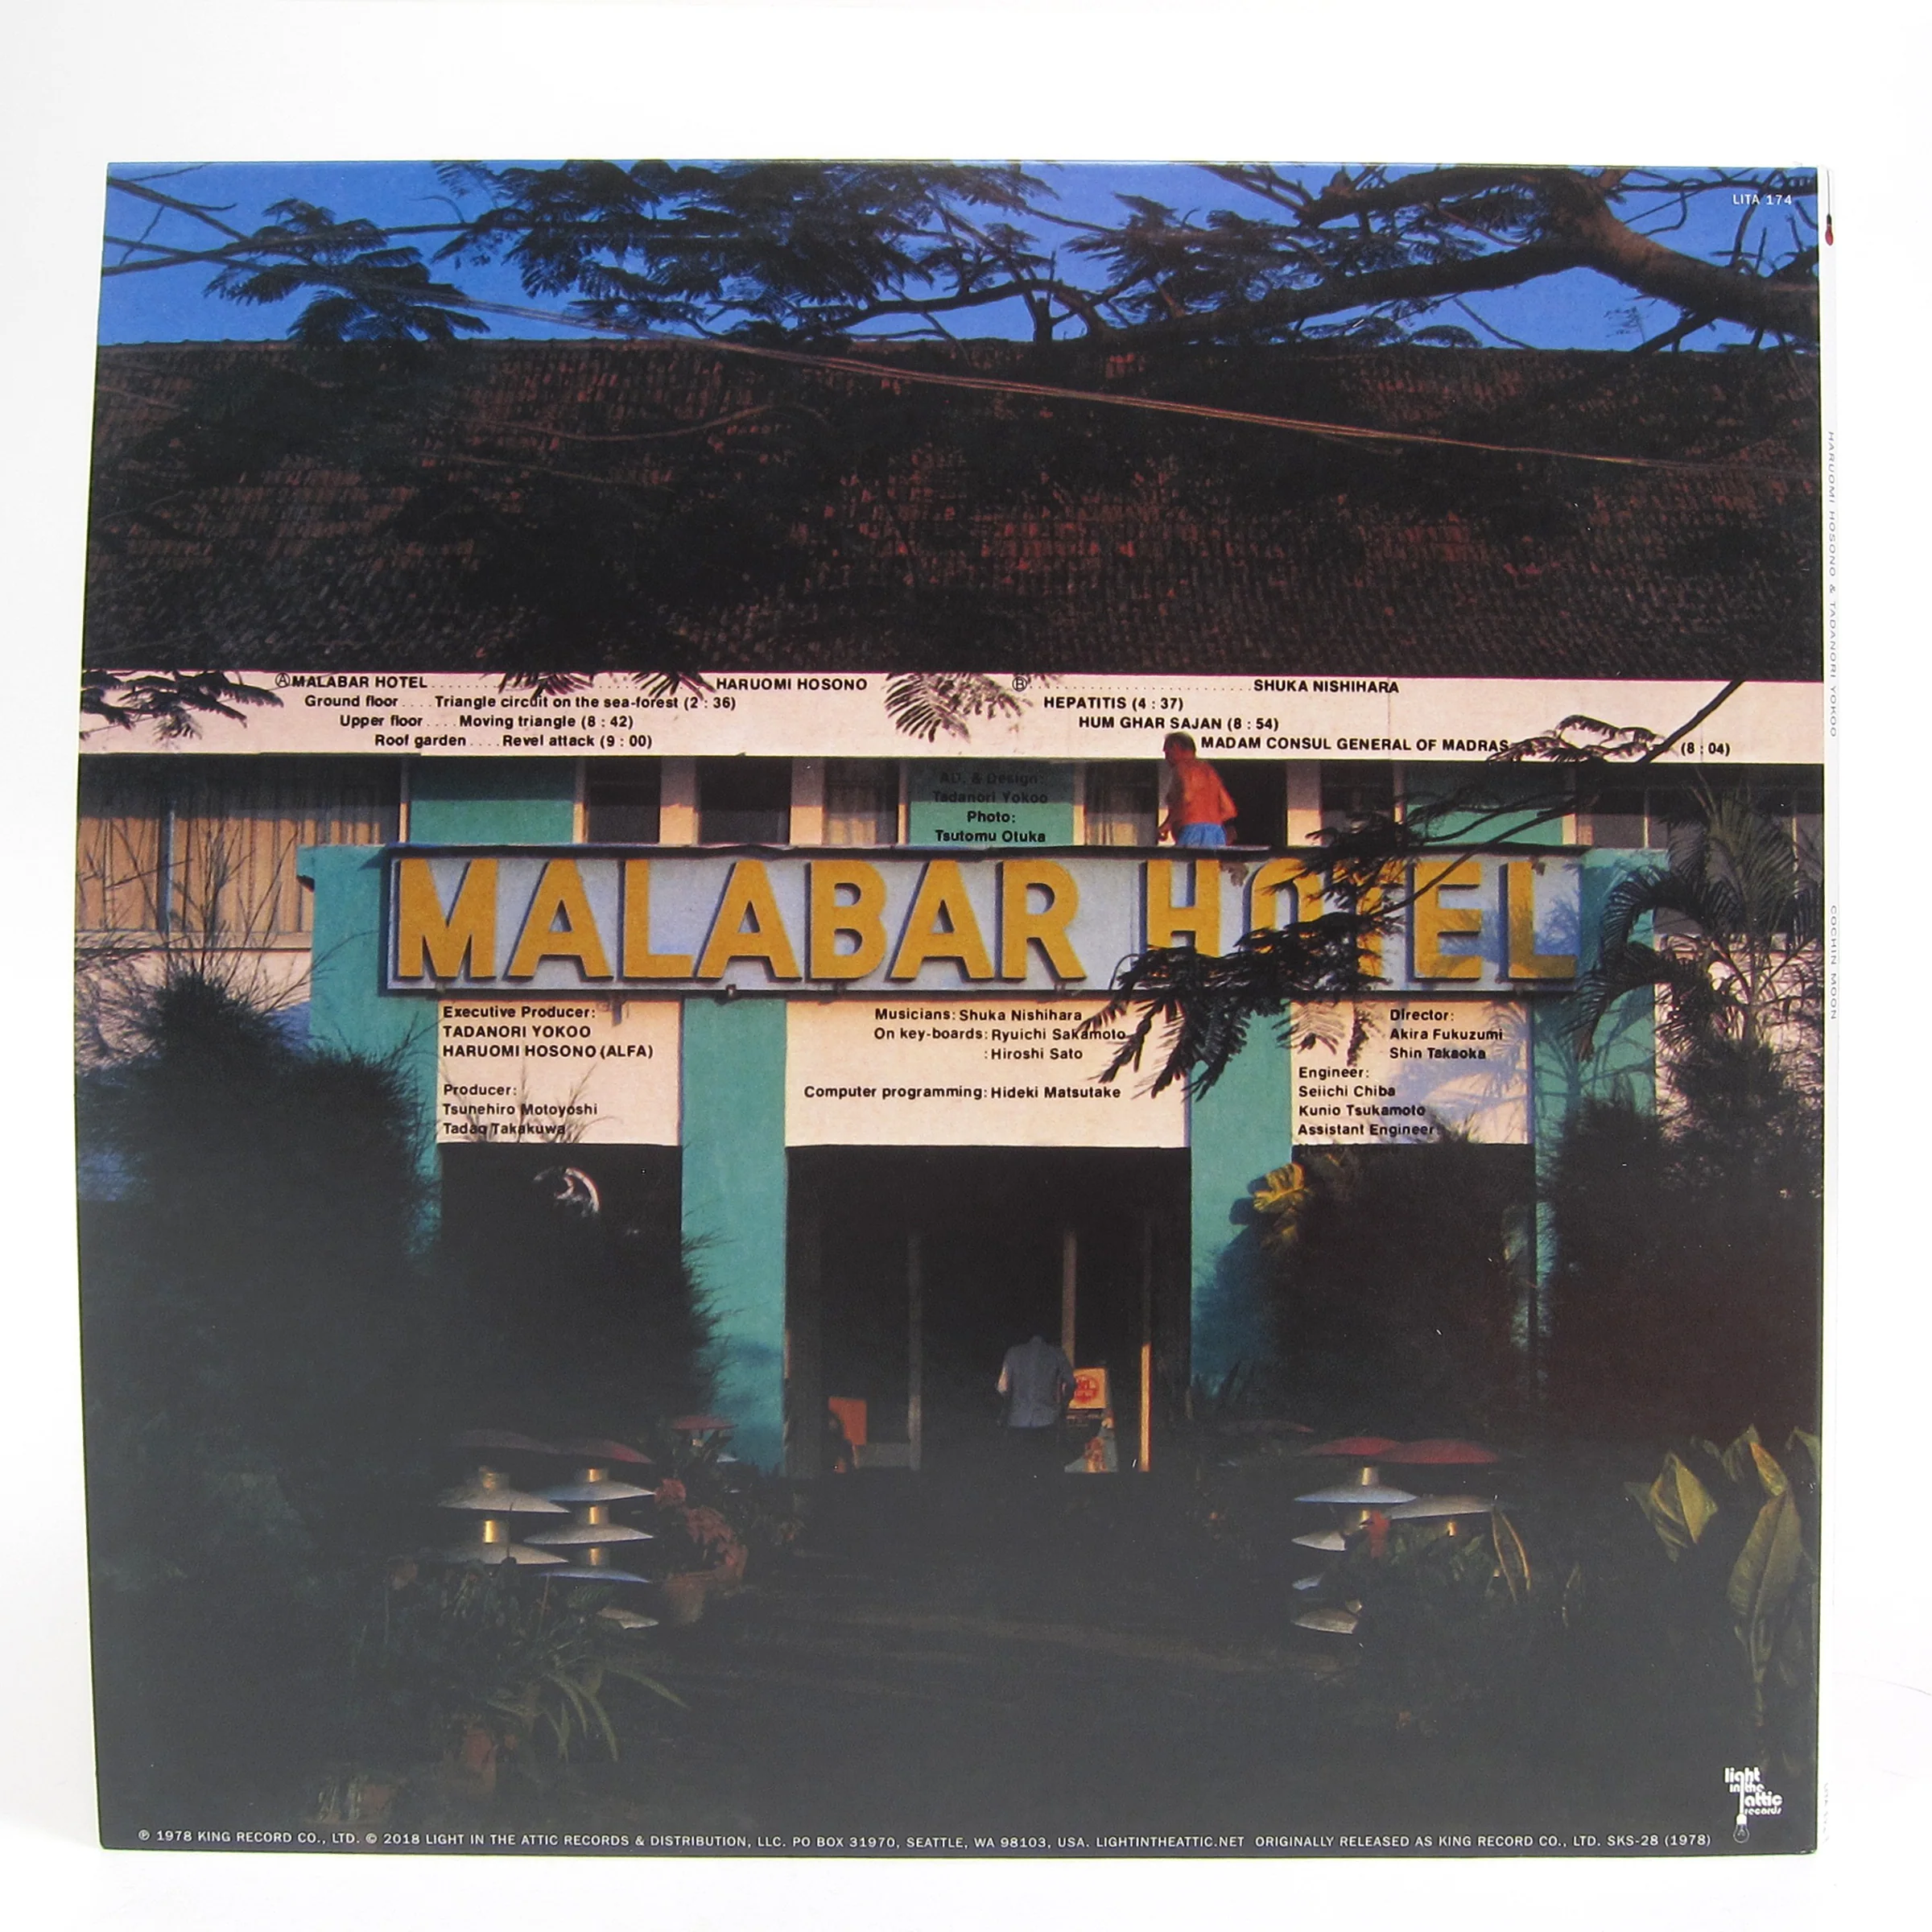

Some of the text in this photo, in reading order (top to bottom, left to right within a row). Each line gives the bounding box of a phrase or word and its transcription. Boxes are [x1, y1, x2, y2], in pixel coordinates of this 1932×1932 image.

[1733, 194, 1792, 205] LITA 174
[292, 675, 369, 687] MALABAR
[375, 676, 427, 688] HOTEL
[716, 678, 792, 690] HARUOMI
[797, 678, 868, 691] HOSONO
[1253, 679, 1309, 691] SHUKA
[1313, 680, 1399, 693] NISHIHARA
[304, 696, 360, 708] Ground
[365, 696, 398, 708] floor
[435, 696, 496, 709] Triangle
[501, 696, 547, 708] circuit
[554, 698, 571, 708] on
[576, 696, 599, 708] the
[604, 696, 678, 709] sea-forest
[1044, 696, 1127, 709] HEPATITIS
[340, 715, 385, 729] Upper
[390, 715, 423, 727] floor
[460, 715, 514, 729] Moving
[518, 716, 576, 729] triangle
[1079, 716, 1115, 729] HUM
[1120, 716, 1165, 729] GHAR
[1170, 717, 1222, 729] SAJAN
[375, 734, 411, 746] Roof
[415, 735, 467, 749] garden
[502, 735, 543, 747] Revel
[549, 735, 595, 747] attack
[1201, 737, 1261, 749] MADAM
[1266, 737, 1331, 749] CONSUL
[1336, 738, 1410, 750] GENERAL
[1416, 740, 1438, 751] OF
[1443, 739, 1509, 752] MADRAS
[933, 791, 1048, 803] Tadanori Yokoo
[967, 811, 1015, 823] Photo:
[935, 830, 1046, 842] Tsutomu Otuka
[396, 857, 1088, 981] MALABAR
[443, 1006, 596, 1018] Executive Producer:
[875, 1009, 1082, 1021] Musicians: Shuka Nishihara
[1389, 1009, 1454, 1022] Director:
[443, 1026, 591, 1038] TADANORI YOKOO
[873, 1027, 1126, 1042] On key-boards: Ryuichi Sakamoto
[1389, 1029, 1503, 1040] Akira Fukuzumi
[443, 1045, 654, 1059] HARUOMI HOSONO (ALFA)
[1050, 1048, 1084, 1060] Sato
[1389, 1047, 1486, 1059] Shin Takaoka
[1298, 1067, 1368, 1080] Engineer:
[444, 1084, 517, 1096] Producer:
[804, 1086, 1121, 1100] Computer programming: Hideki Matsutake
[1298, 1086, 1396, 1097] Seiichi Chiba
[443, 1104, 597, 1117] Tsunehiro Motoyoshi
[1298, 1105, 1426, 1117] Kunio Tsukamoto
[443, 1122, 566, 1135] Tadao Takakuwa
[1298, 1124, 1434, 1137] Assistant Engineer
[1724, 1767, 1761, 1783] light
[1744, 1783, 1765, 1793] the
[1744, 1791, 1783, 1807] attic
[1744, 1807, 1781, 1815] records
[156, 1831, 192, 1842] 1978
[197, 1831, 231, 1843] KING
[237, 1832, 292, 1843] RECORD
[297, 1833, 326, 1844] CO.,
[332, 1833, 360, 1844] LTD.
[382, 1834, 420, 1844] 2018
[426, 1834, 464, 1845] LIGHT
[470, 1835, 484, 1845] IN
[489, 1835, 516, 1845] THE
[521, 1835, 559, 1846] ATTIC
[564, 1835, 630, 1846] RECORDS
[635, 1835, 645, 1847] &
[650, 1835, 751, 1848] DISTRIBUTION,
[758, 1836, 786, 1847] LLC.
[792, 1836, 811, 1847] PO
[816, 1836, 844, 1847] BOX
[849, 1836, 900, 1849] 31970,
[906, 1837, 968, 1850] SEATTLE,
[973, 1837, 995, 1848] WA
[1001, 1837, 1051, 1850] 98103,
[1058, 1837, 1090, 1848] USA.
[1096, 1837, 1245, 1848] LIGHTINTHEATTIC.NET
[1254, 1836, 1335, 1847] ORIGINALLY
[1339, 1836, 1410, 1847] RELEASED
[1414, 1835, 1432, 1847] AS
[1438, 1835, 1472, 1847] KING
[1477, 1835, 1534, 1847] RECORD
[1539, 1835, 1567, 1849] CO.,
[1573, 1835, 1600, 1847] LTD.
[1607, 1835, 1659, 1847] SKS-28
[1664, 1834, 1711, 1848] (1978)
